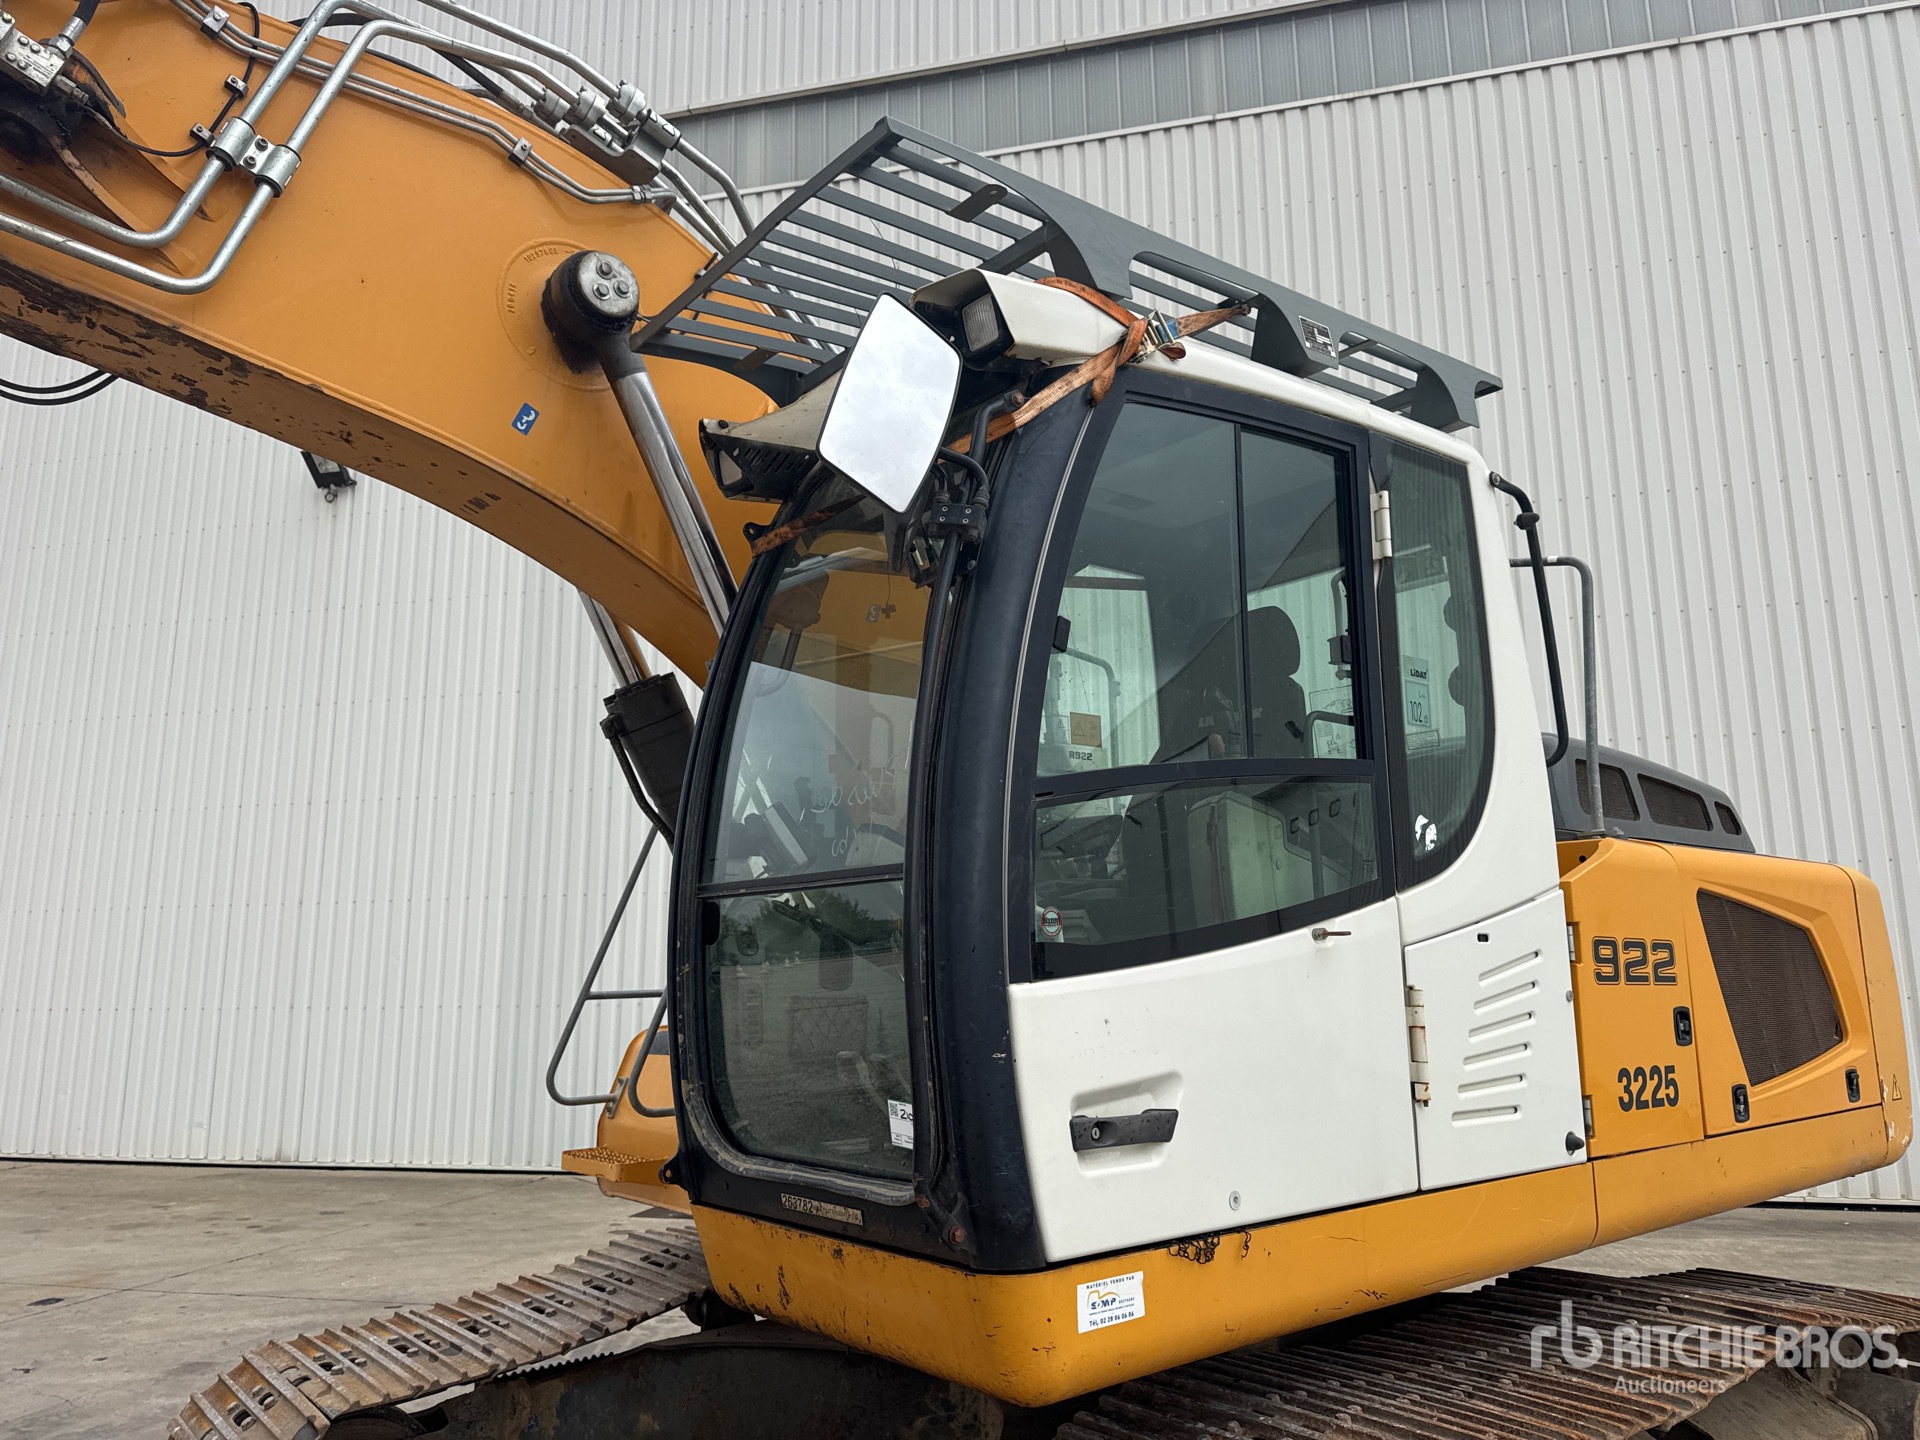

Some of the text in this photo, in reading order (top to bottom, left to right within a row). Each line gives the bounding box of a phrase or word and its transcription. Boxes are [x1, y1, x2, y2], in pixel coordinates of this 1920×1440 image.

[1409, 700, 1423, 723] 102
[1068, 750, 1093, 761] R922
[1592, 936, 1678, 986] 922
[1618, 1065, 1680, 1112] 3225
[782, 1195, 813, 1213] 263782
[1100, 1317, 1107, 1325] 02
